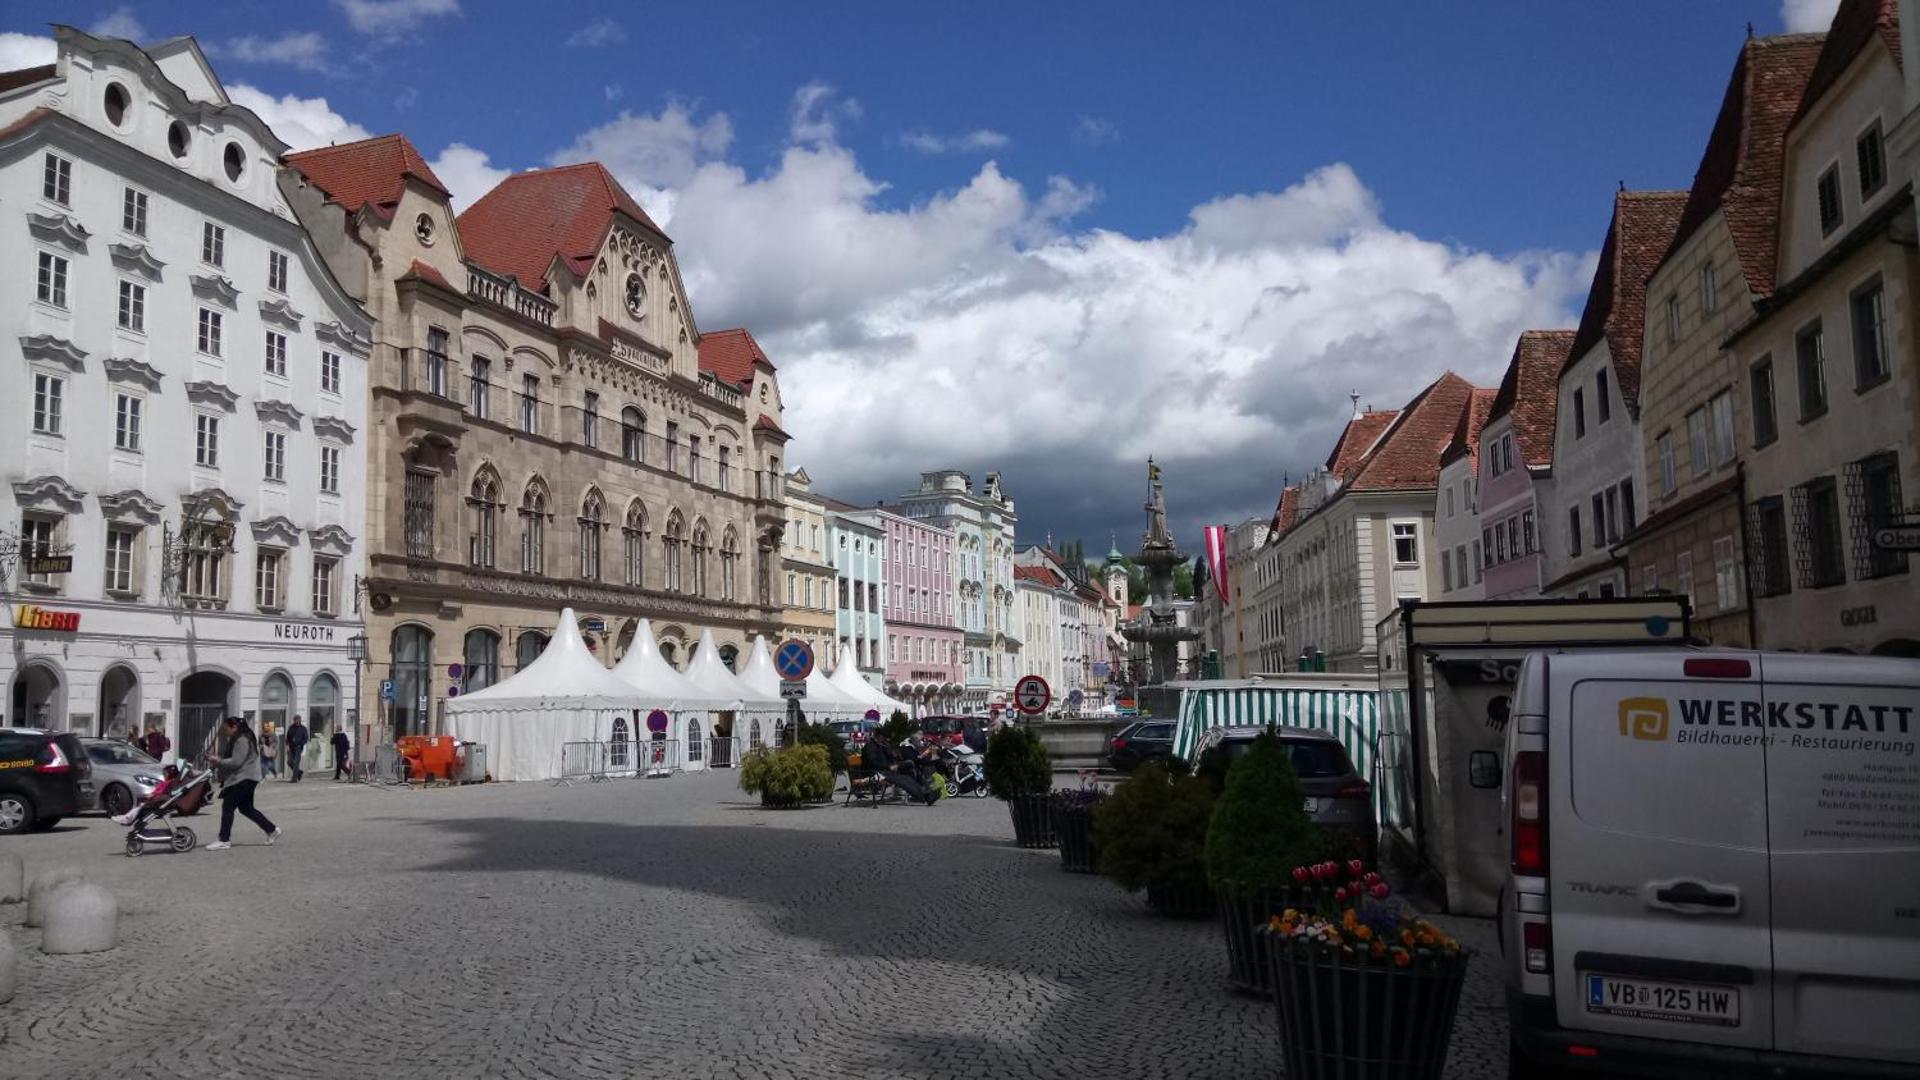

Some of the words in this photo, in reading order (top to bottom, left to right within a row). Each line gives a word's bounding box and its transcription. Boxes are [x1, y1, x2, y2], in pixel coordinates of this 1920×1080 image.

[274, 624, 334, 640] NEUROTH
[383, 681, 392, 694] P
[1678, 699, 1914, 733] WERKSTATT
[1677, 730, 1776, 746] Bildhauerei
[1791, 734, 1916, 756] Restaurierung
[1567, 882, 1638, 897] TRAFIC
[1608, 982, 1635, 1004] VB
[1653, 987, 1692, 1011] 125
[1697, 990, 1730, 1015] HW
